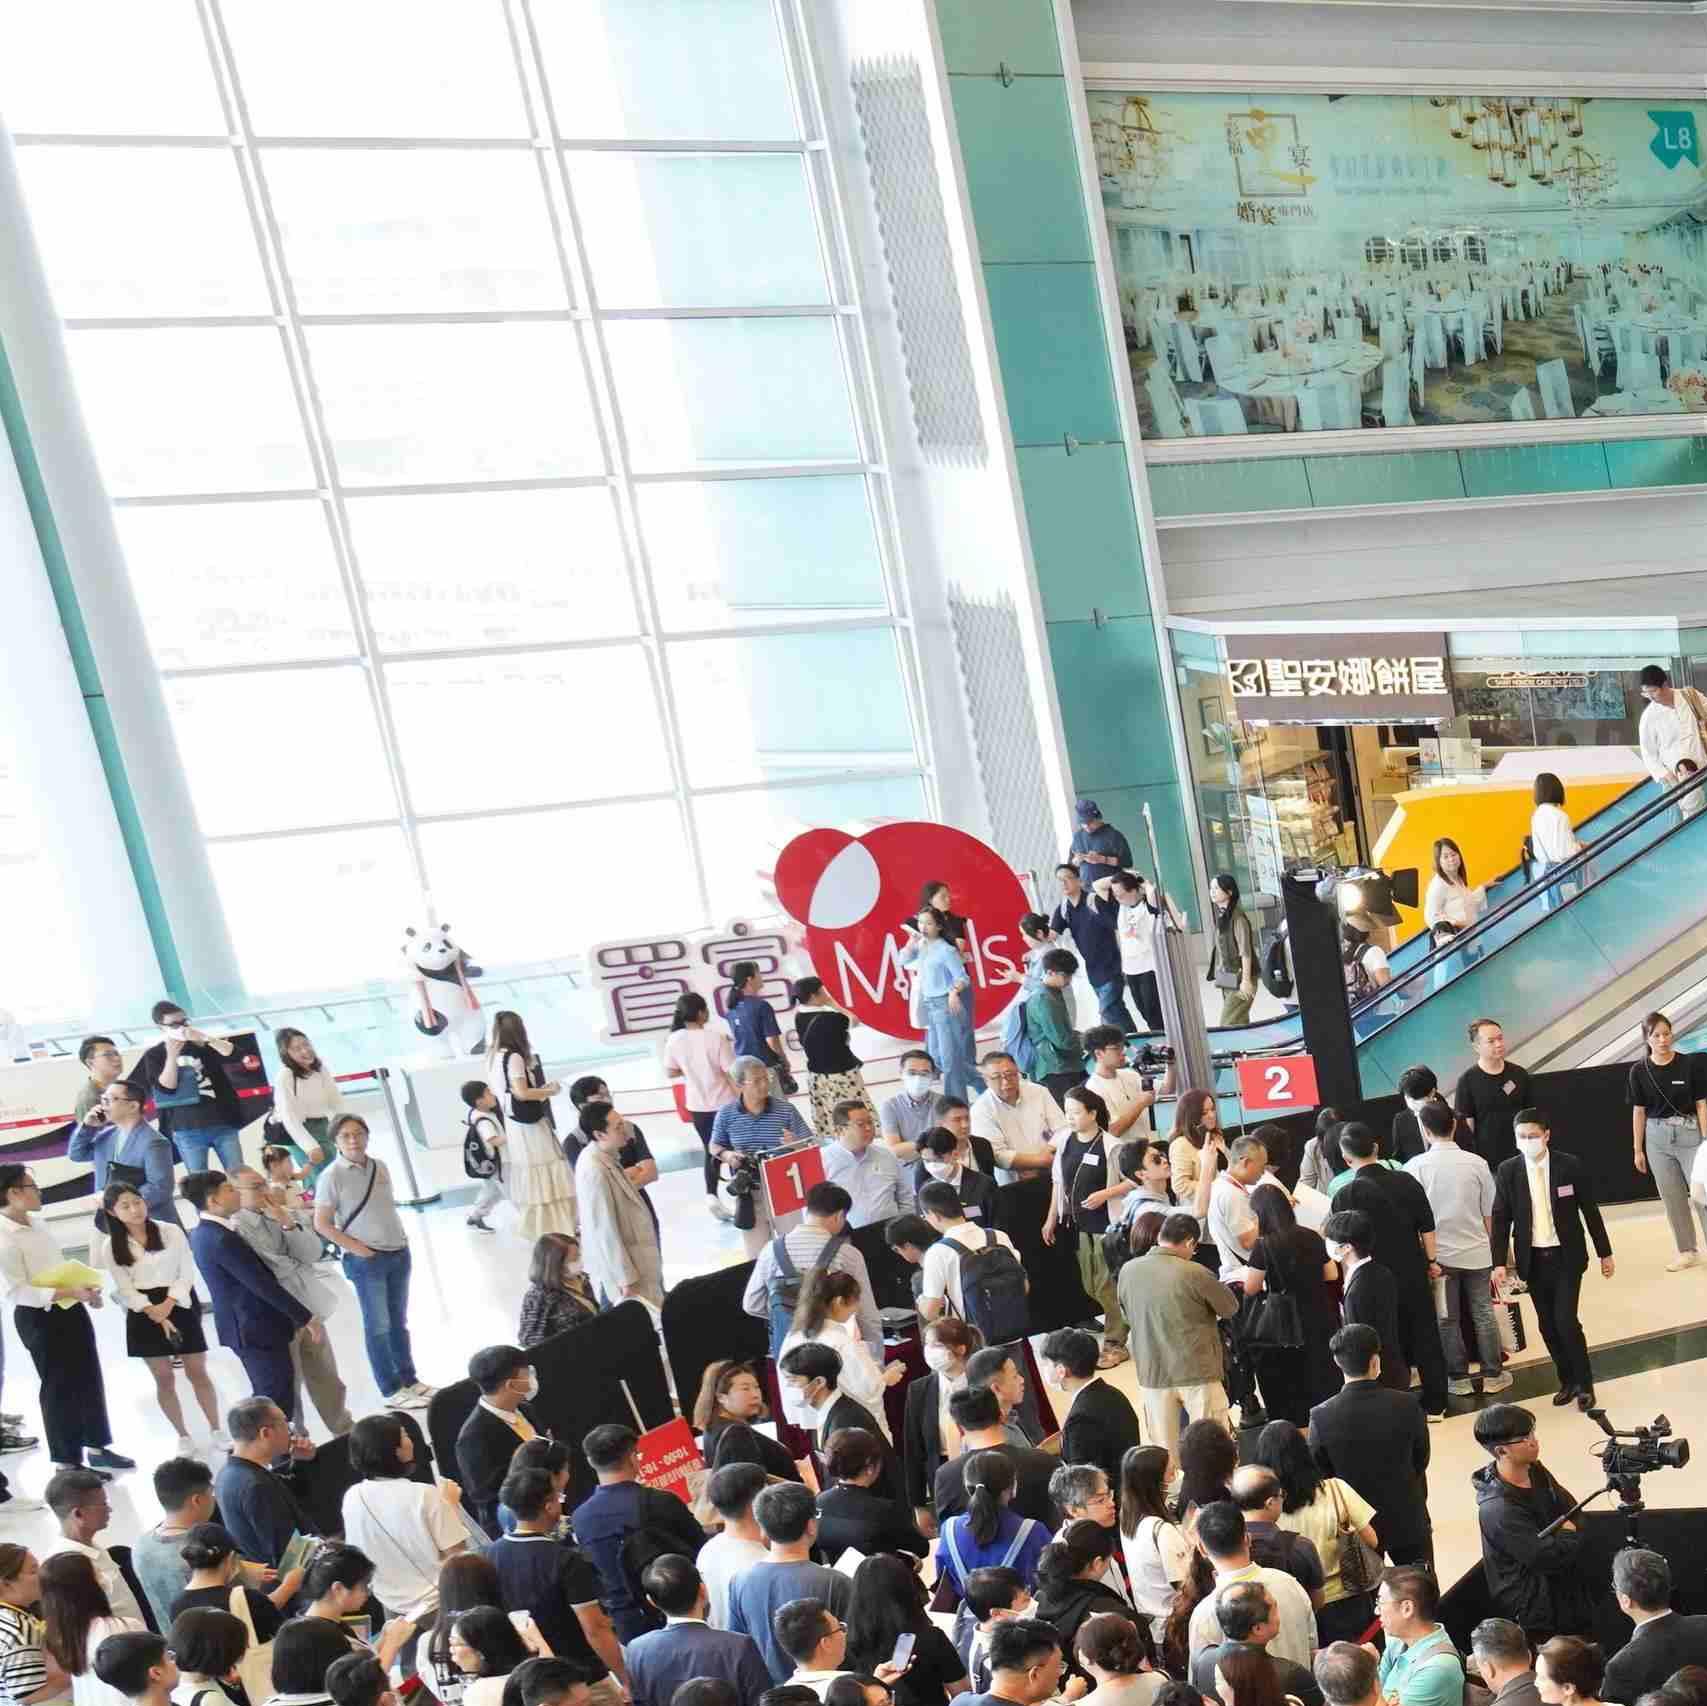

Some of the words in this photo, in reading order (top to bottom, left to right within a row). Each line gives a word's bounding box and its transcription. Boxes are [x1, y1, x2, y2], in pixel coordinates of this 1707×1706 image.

[1662, 126, 1693, 152] L8
[1264, 656, 1449, 697] 聖安娜餅屋
[833, 918, 1010, 1009] Mls
[1263, 1066, 1293, 1100] 2
[784, 1167, 803, 1200] 1
